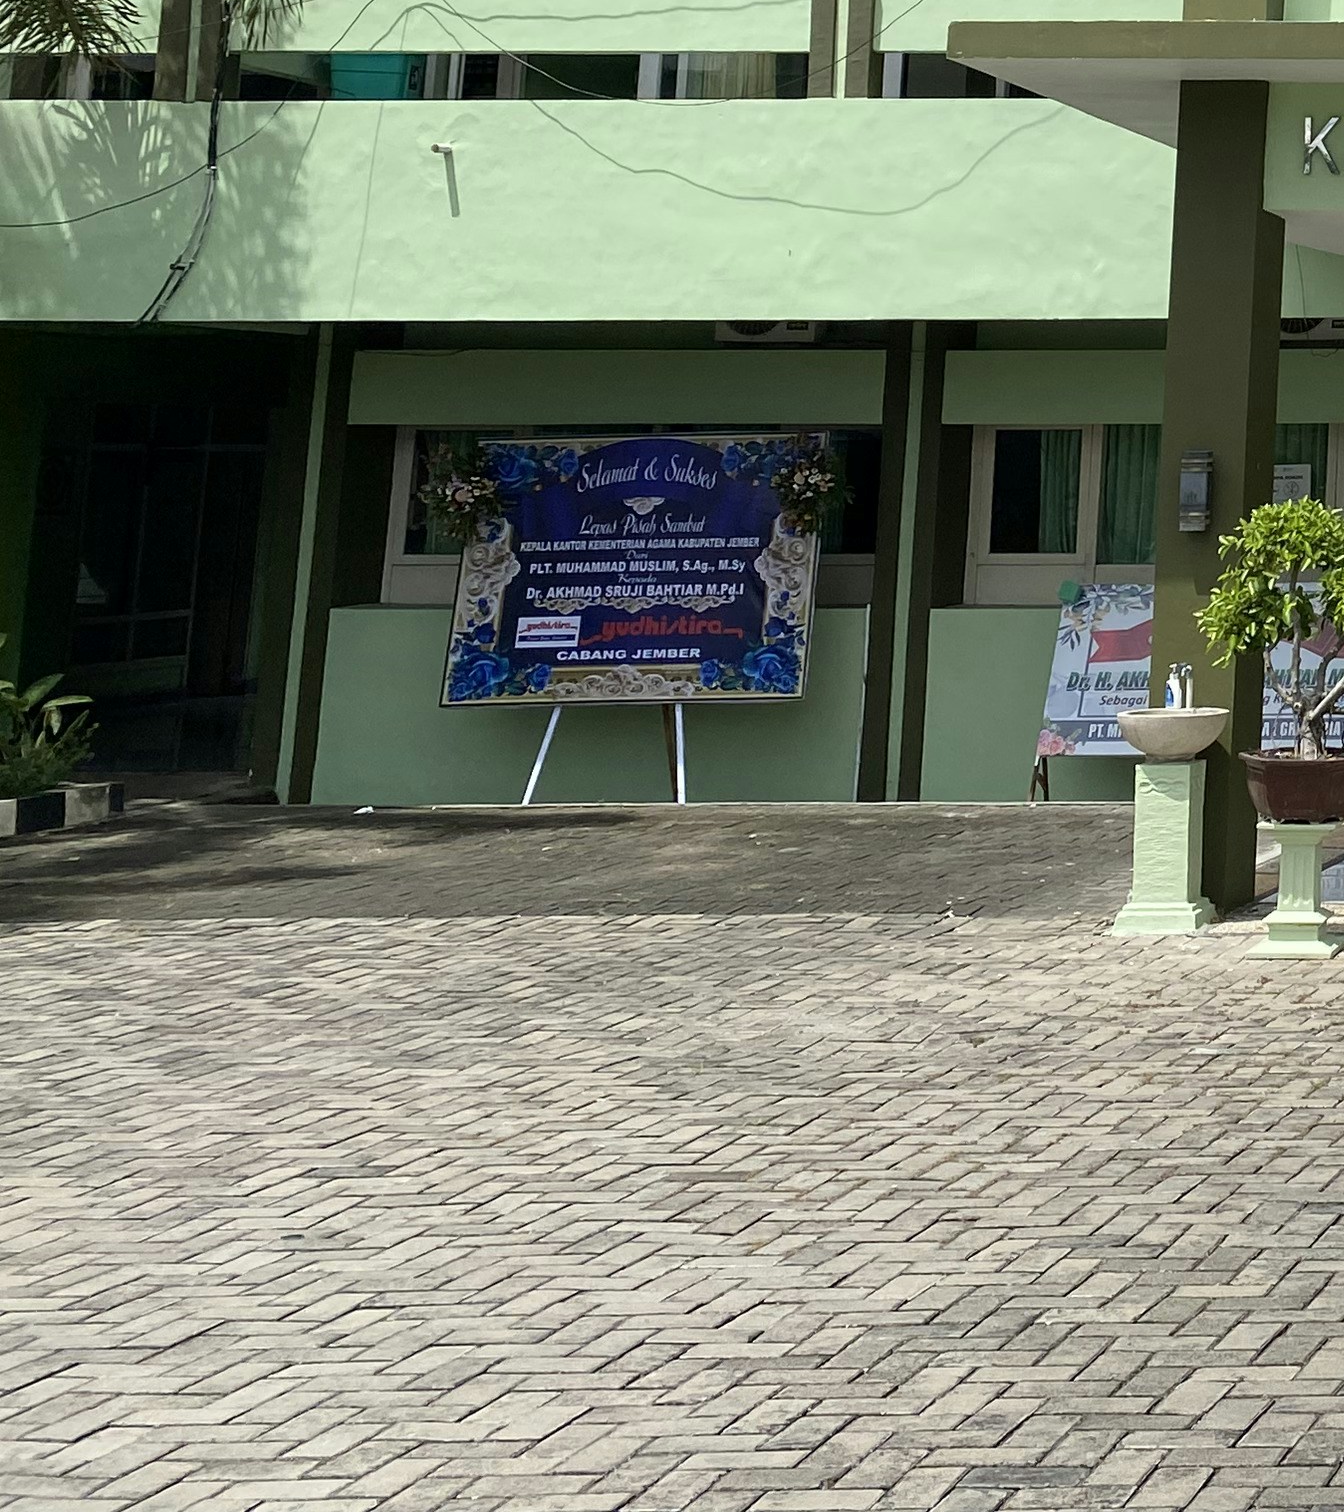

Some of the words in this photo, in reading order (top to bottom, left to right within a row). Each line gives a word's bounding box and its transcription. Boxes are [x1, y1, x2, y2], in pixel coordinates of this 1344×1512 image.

[577, 457, 641, 493] Selamat
[643, 456, 659, 481] &
[664, 453, 718, 490] Sukses
[578, 514, 618, 537] Lepas
[620, 513, 657, 536] Pisah
[659, 512, 706, 534] Sambut
[520, 540, 552, 552] KEPALA
[553, 539, 587, 551] KANTOR
[588, 539, 646, 550] KEMENTERIAN
[647, 539, 676, 550] AGAMA
[678, 538, 726, 549] KABUPATEN
[727, 537, 760, 548] JEMBER
[529, 562, 553, 574] PLT.
[556, 561, 626, 574] MUHAMMAD
[629, 560, 679, 574] MUSLIM,
[683, 559, 716, 574] S.Ag.,
[718, 559, 745, 573] M.Sy
[526, 587, 543, 600] Dr.
[546, 585, 602, 599] AKHMAD
[605, 585, 644, 597] SRUJI
[646, 583, 702, 597] BAHTIAR
[705, 582, 745, 596] M.Pd.I
[556, 649, 628, 662] CABANG
[631, 648, 702, 660] JEMBER
[1066, 670, 1091, 692] Dr.
[1095, 670, 1114, 692] H.
[1099, 694, 1149, 707] Sebagai
[1088, 723, 1104, 738] PT.
